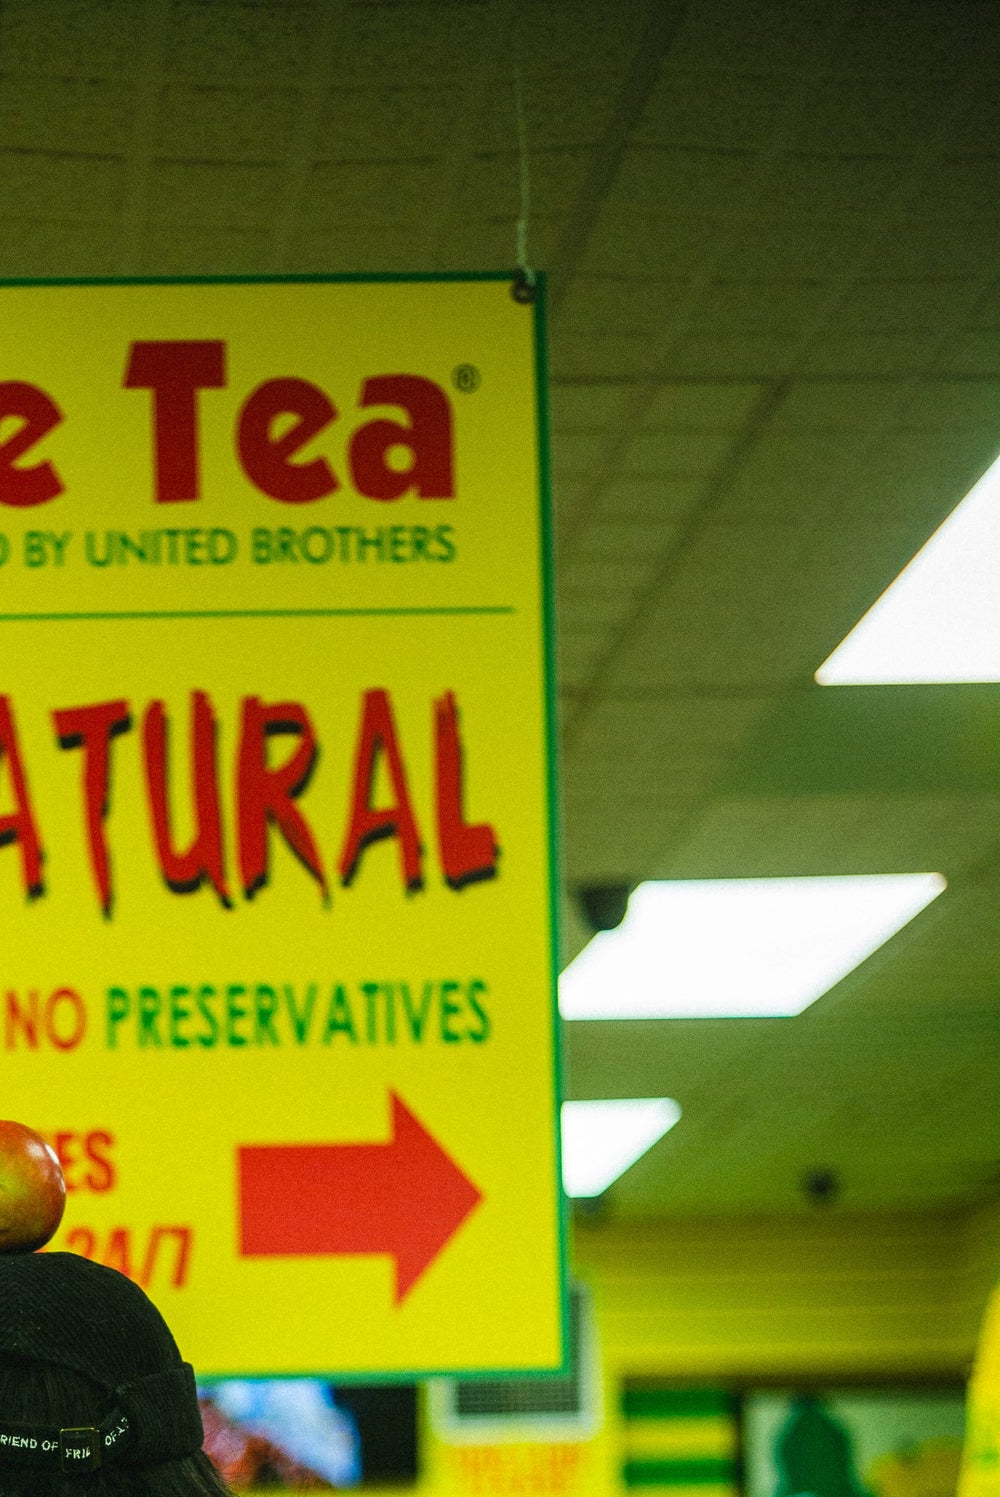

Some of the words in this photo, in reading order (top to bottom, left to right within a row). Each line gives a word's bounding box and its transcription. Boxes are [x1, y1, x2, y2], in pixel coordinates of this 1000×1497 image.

[24, 528, 73, 570] BY
[85, 527, 238, 569] UNITED
[251, 523, 457, 567] BROTHERS
[3, 986, 87, 1053] NO
[105, 976, 491, 1051] PRESERVATIVES
[41, 1440, 59, 1452] OF
